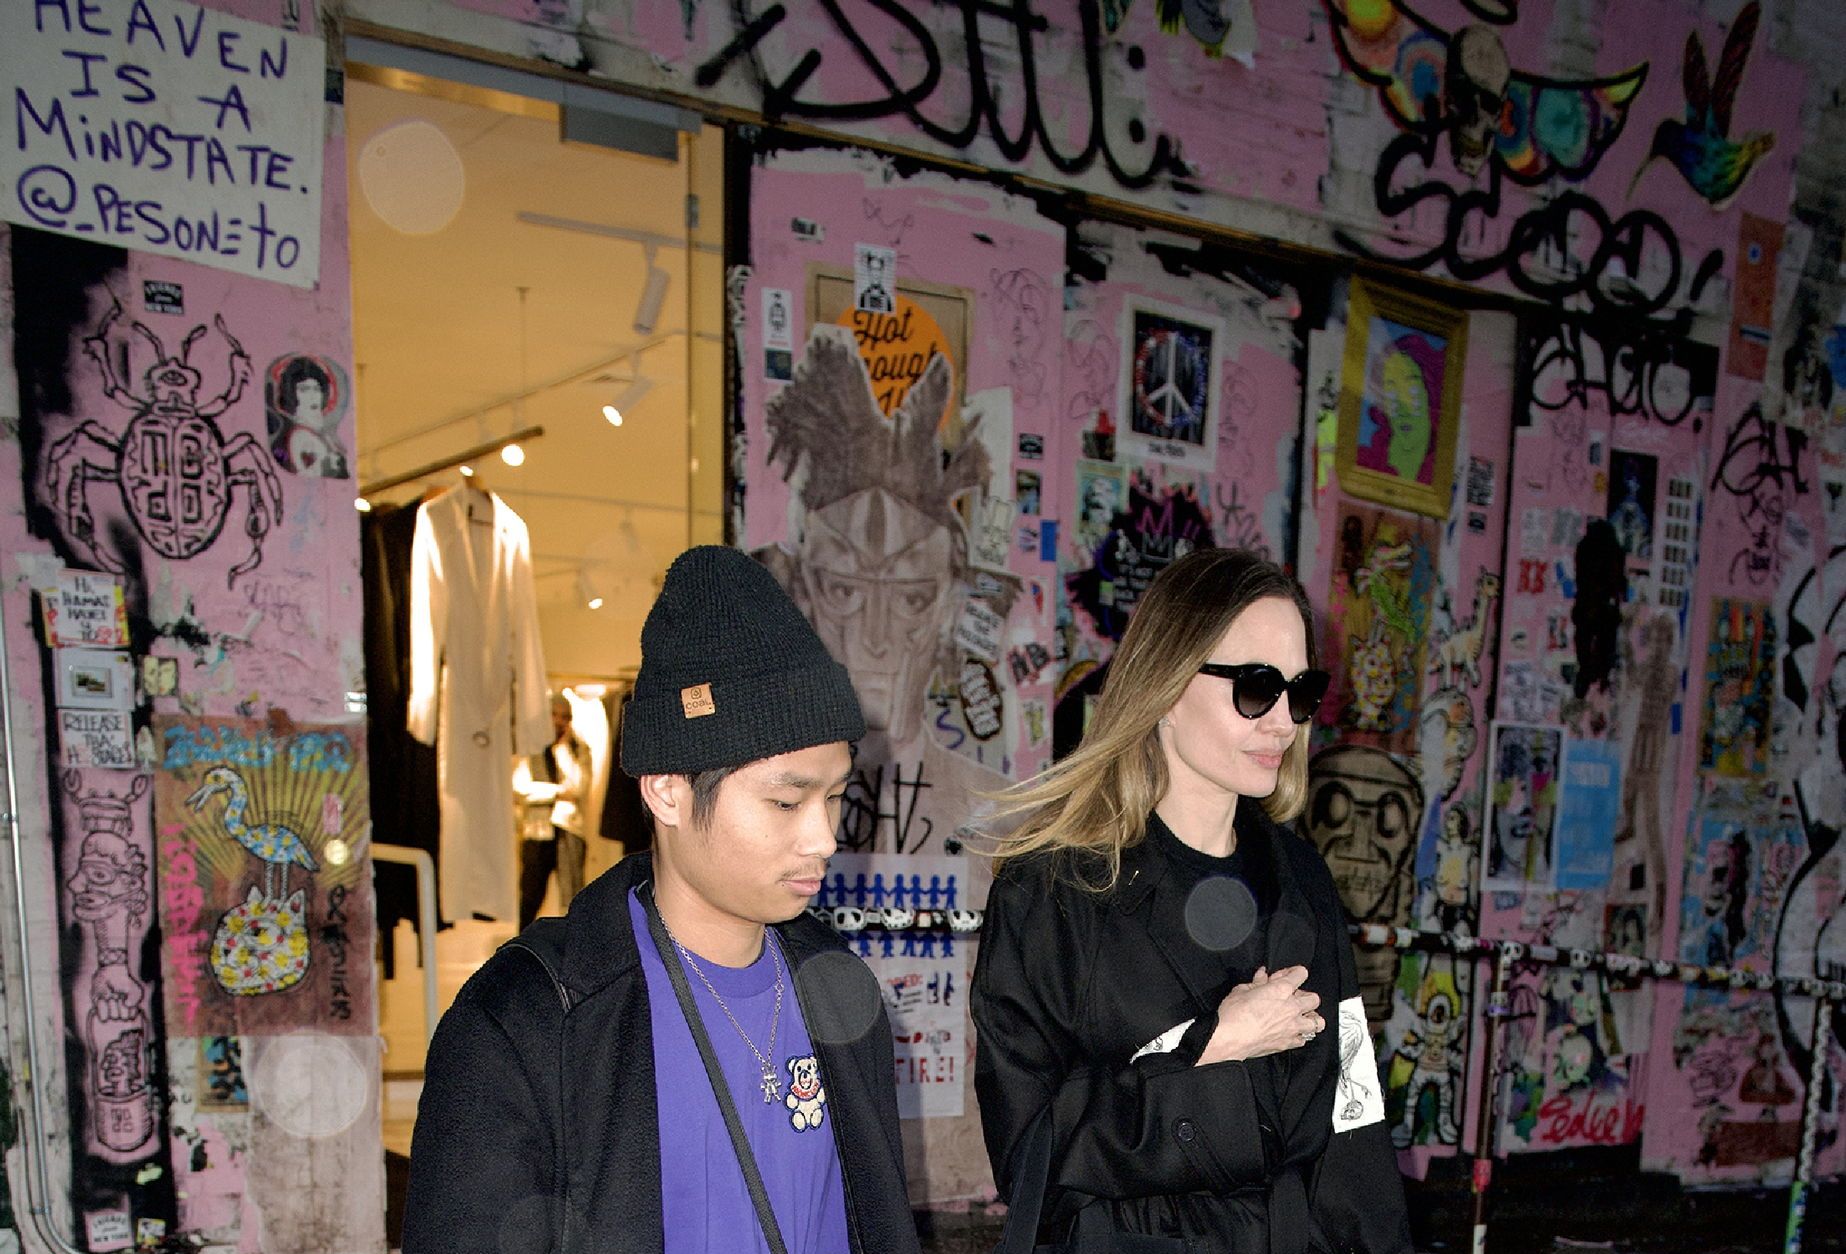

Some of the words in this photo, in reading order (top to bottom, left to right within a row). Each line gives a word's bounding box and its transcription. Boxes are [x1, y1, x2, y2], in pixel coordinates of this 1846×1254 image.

[34, 0, 288, 80] HEAVEN
[61, 51, 156, 104] IS
[197, 84, 251, 133] A
[853, 305, 914, 350] Hot
